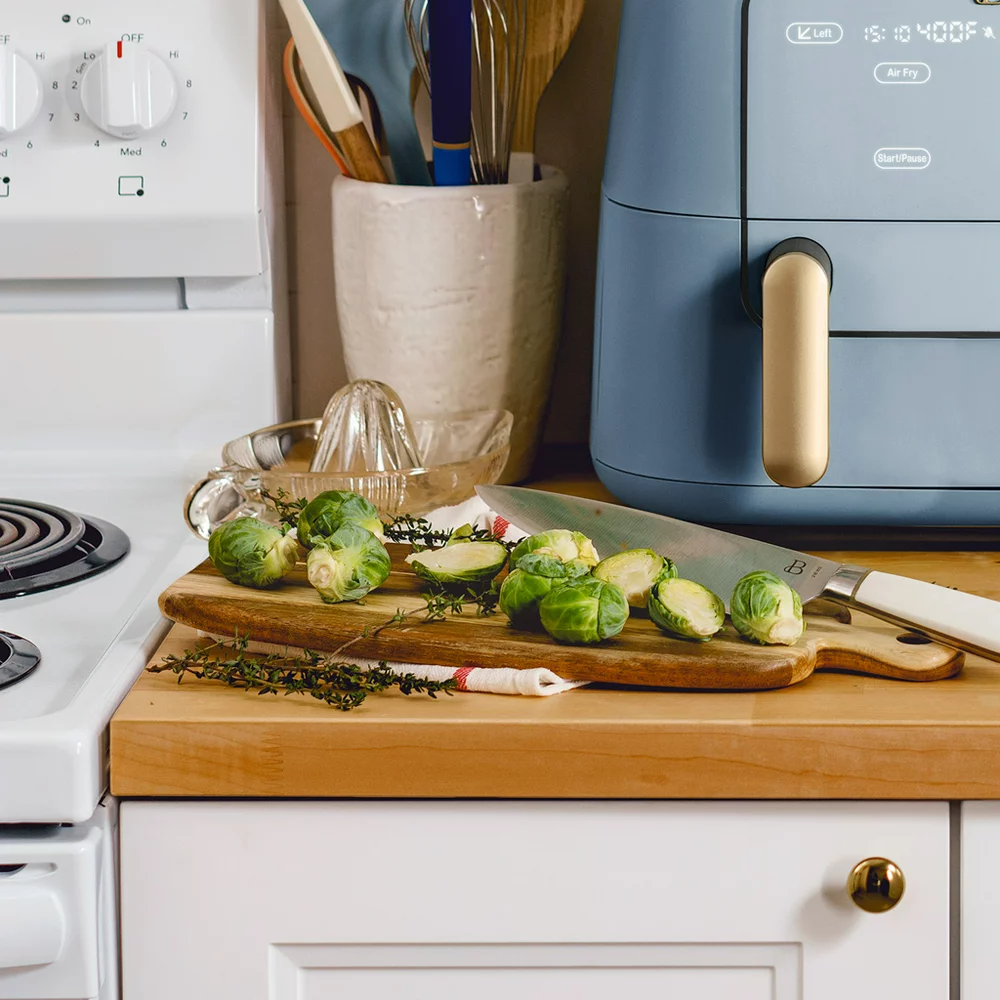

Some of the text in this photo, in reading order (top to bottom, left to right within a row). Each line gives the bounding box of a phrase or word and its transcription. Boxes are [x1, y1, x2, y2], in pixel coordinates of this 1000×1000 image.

[77, 16, 91, 26] On
[813, 28, 833, 38] Left
[917, 21, 978, 43] 400F
[121, 33, 144, 43] OFF
[35, 52, 46, 60] Hi
[83, 52, 96, 60] Lo
[169, 51, 179, 59] Hi
[887, 67, 919, 80] Air Fry
[52, 81, 59, 90] 8
[71, 81, 78, 90] 2
[186, 79, 192, 88] 8
[49, 112, 55, 122] 7
[74, 113, 80, 122] 3
[182, 111, 188, 121] 7
[26, 141, 33, 150] 6
[94, 140, 100, 148] 4
[160, 139, 167, 148] 6
[120, 147, 142, 157] Med
[877, 153, 927, 164] Start/Pause
[783, 559, 807, 575] B
